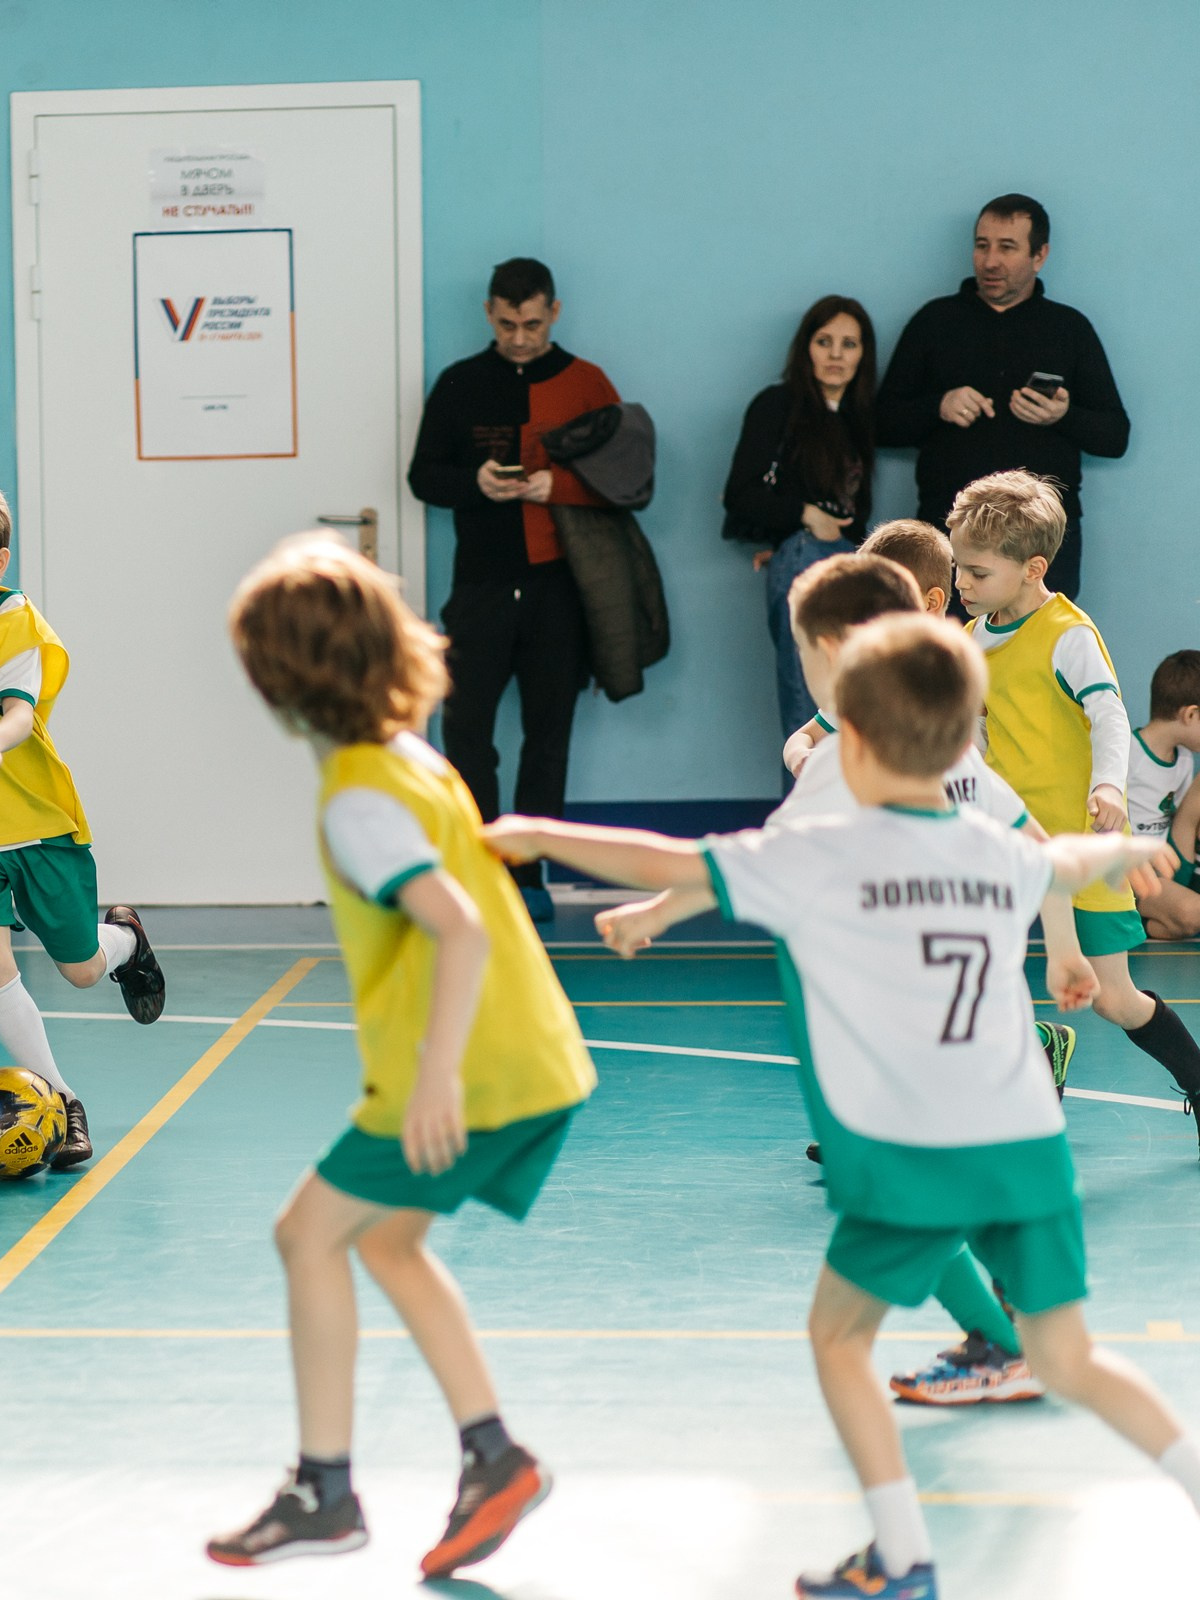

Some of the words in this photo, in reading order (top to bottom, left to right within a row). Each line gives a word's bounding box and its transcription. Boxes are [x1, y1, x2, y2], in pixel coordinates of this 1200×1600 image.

[180, 167, 233, 179] МЯЧОМ
[180, 184, 188, 196] В
[192, 183, 234, 196] ДВЕРЬ
[162, 205, 178, 217] НЕ
[212, 296, 256, 305] ВЫБОРЫ
[207, 307, 271, 317] ПРЕЗИДЕНТА
[202, 321, 242, 330] РОССИИ
[921, 932, 990, 1044] 7
[4, 1146, 38, 1154] adidas
